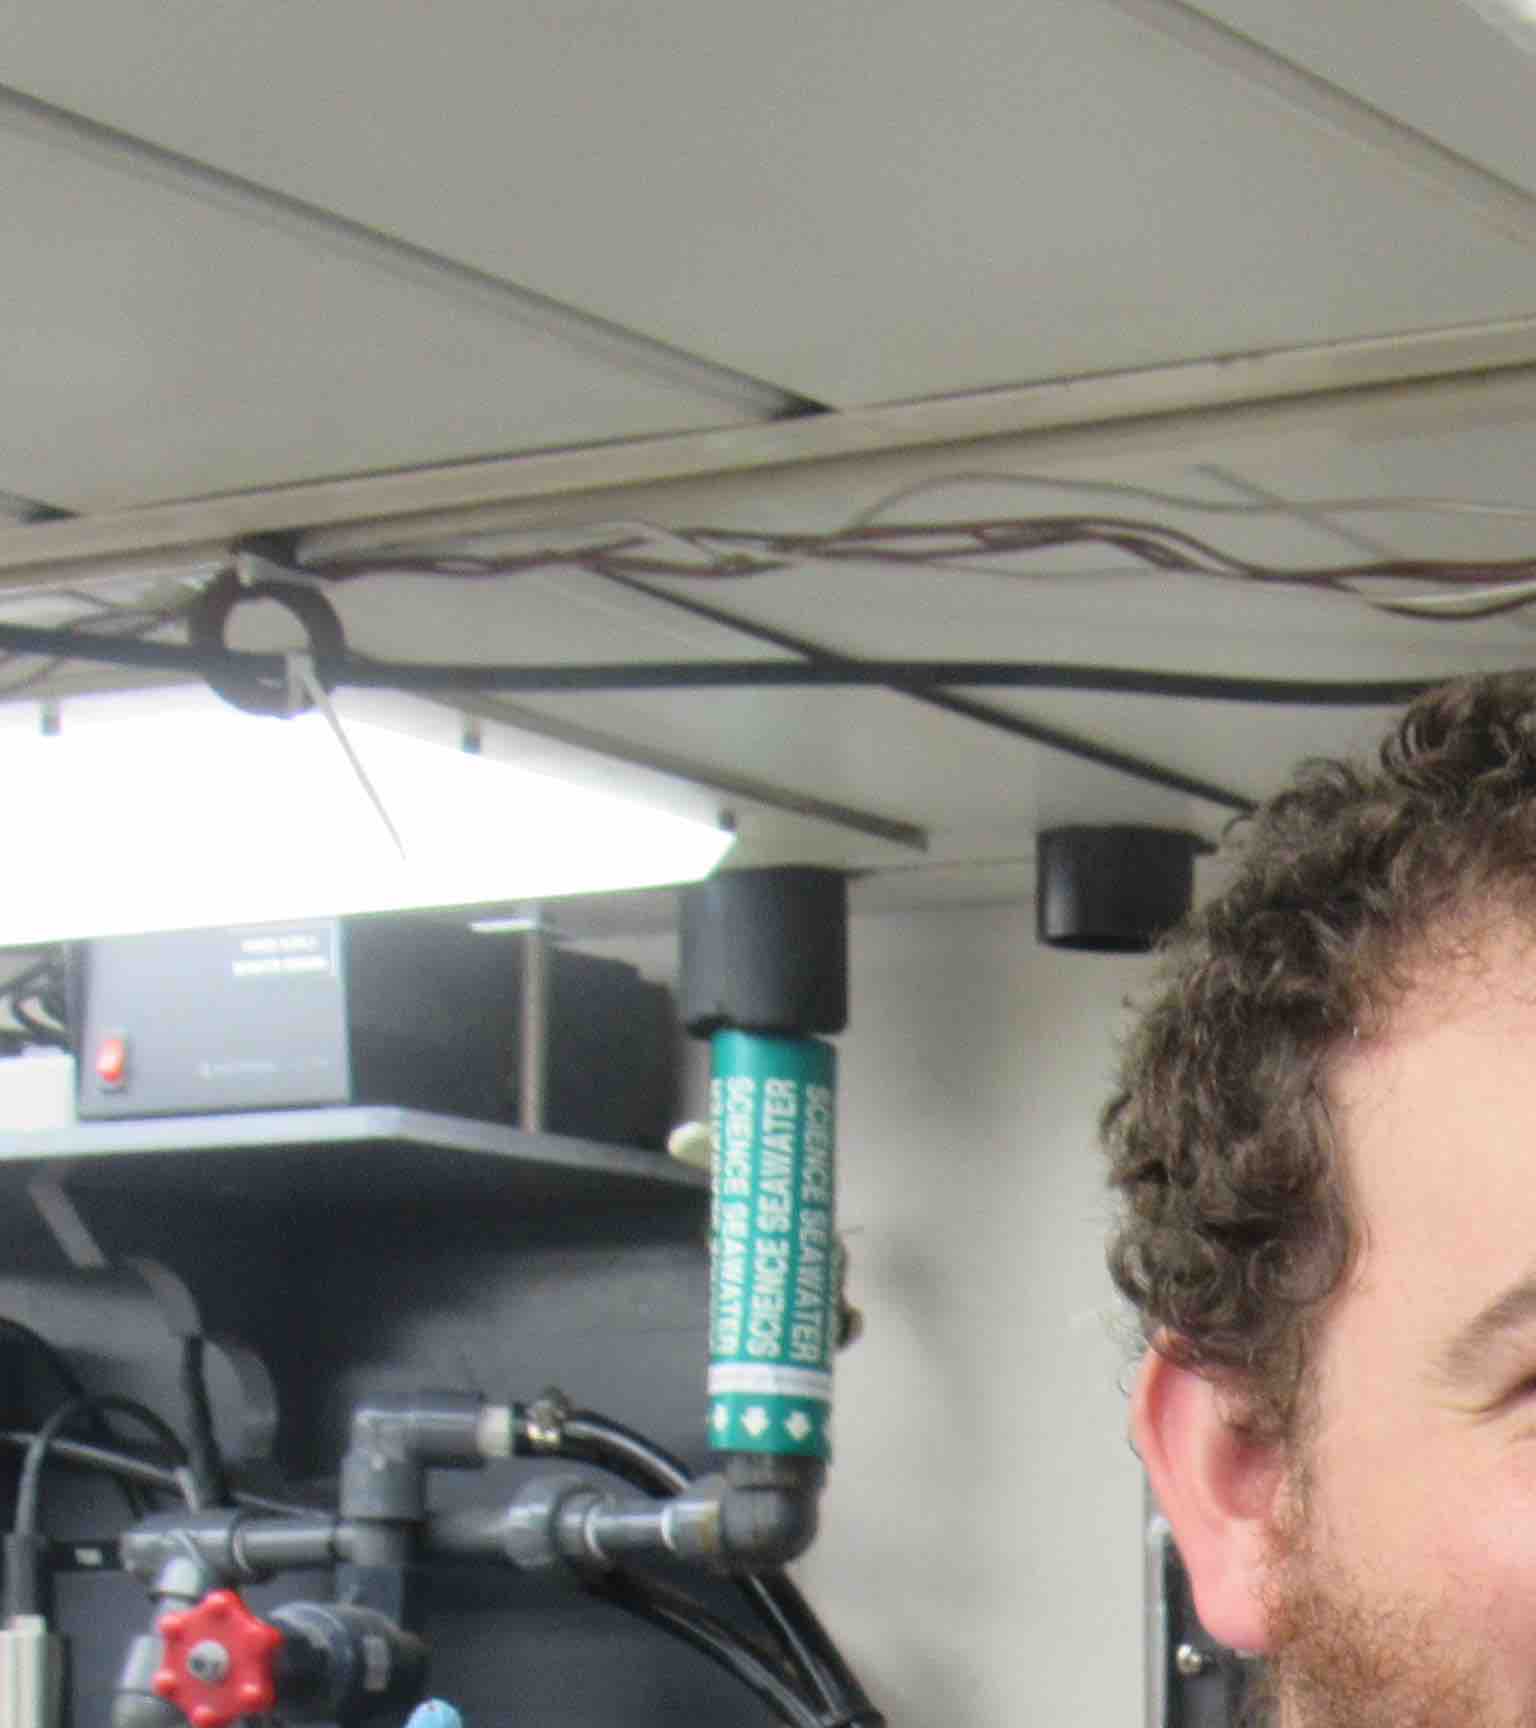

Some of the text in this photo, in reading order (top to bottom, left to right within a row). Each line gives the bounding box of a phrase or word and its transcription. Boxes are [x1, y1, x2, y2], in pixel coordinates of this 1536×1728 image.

[717, 1076, 757, 1356] SCIENCE SEAWATER
[746, 1076, 800, 1358] SCIENCE SEAWATER
[788, 1083, 831, 1363] SCIENCE SEAWATER
